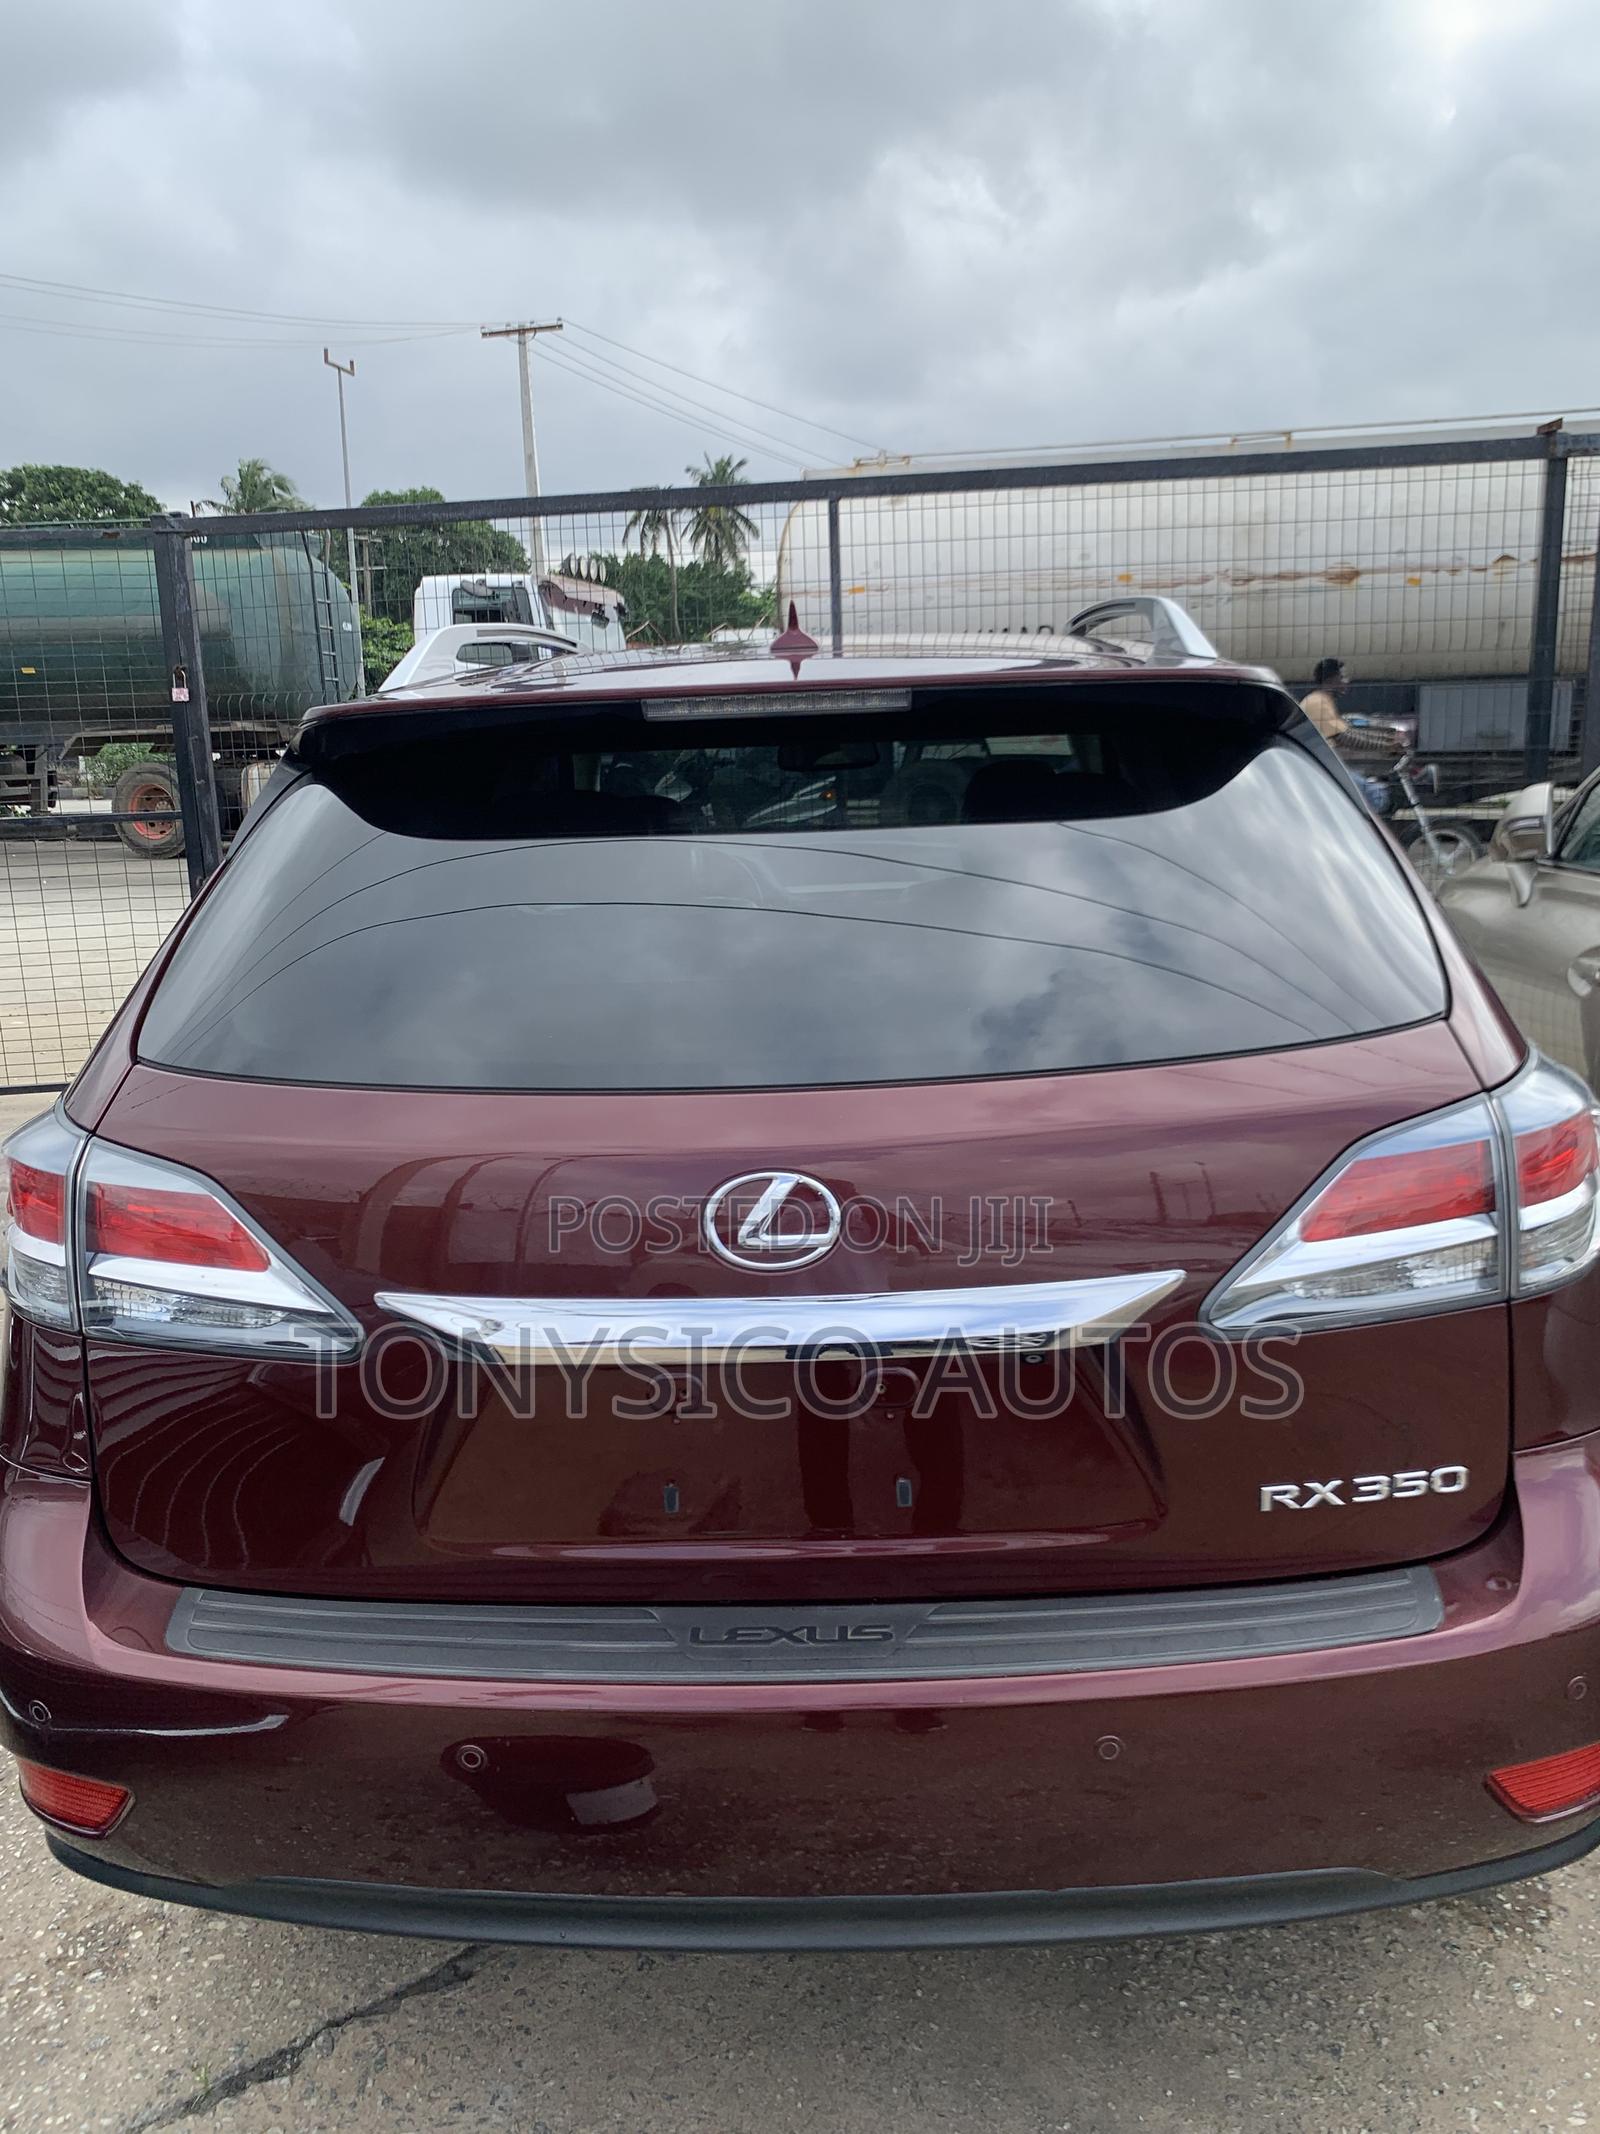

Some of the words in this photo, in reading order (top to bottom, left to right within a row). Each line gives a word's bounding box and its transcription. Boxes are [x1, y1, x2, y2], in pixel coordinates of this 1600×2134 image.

[1259, 1478, 1347, 1512] RX
[1351, 1464, 1470, 1503] 350
[687, 1623, 895, 1645] LEXUS
